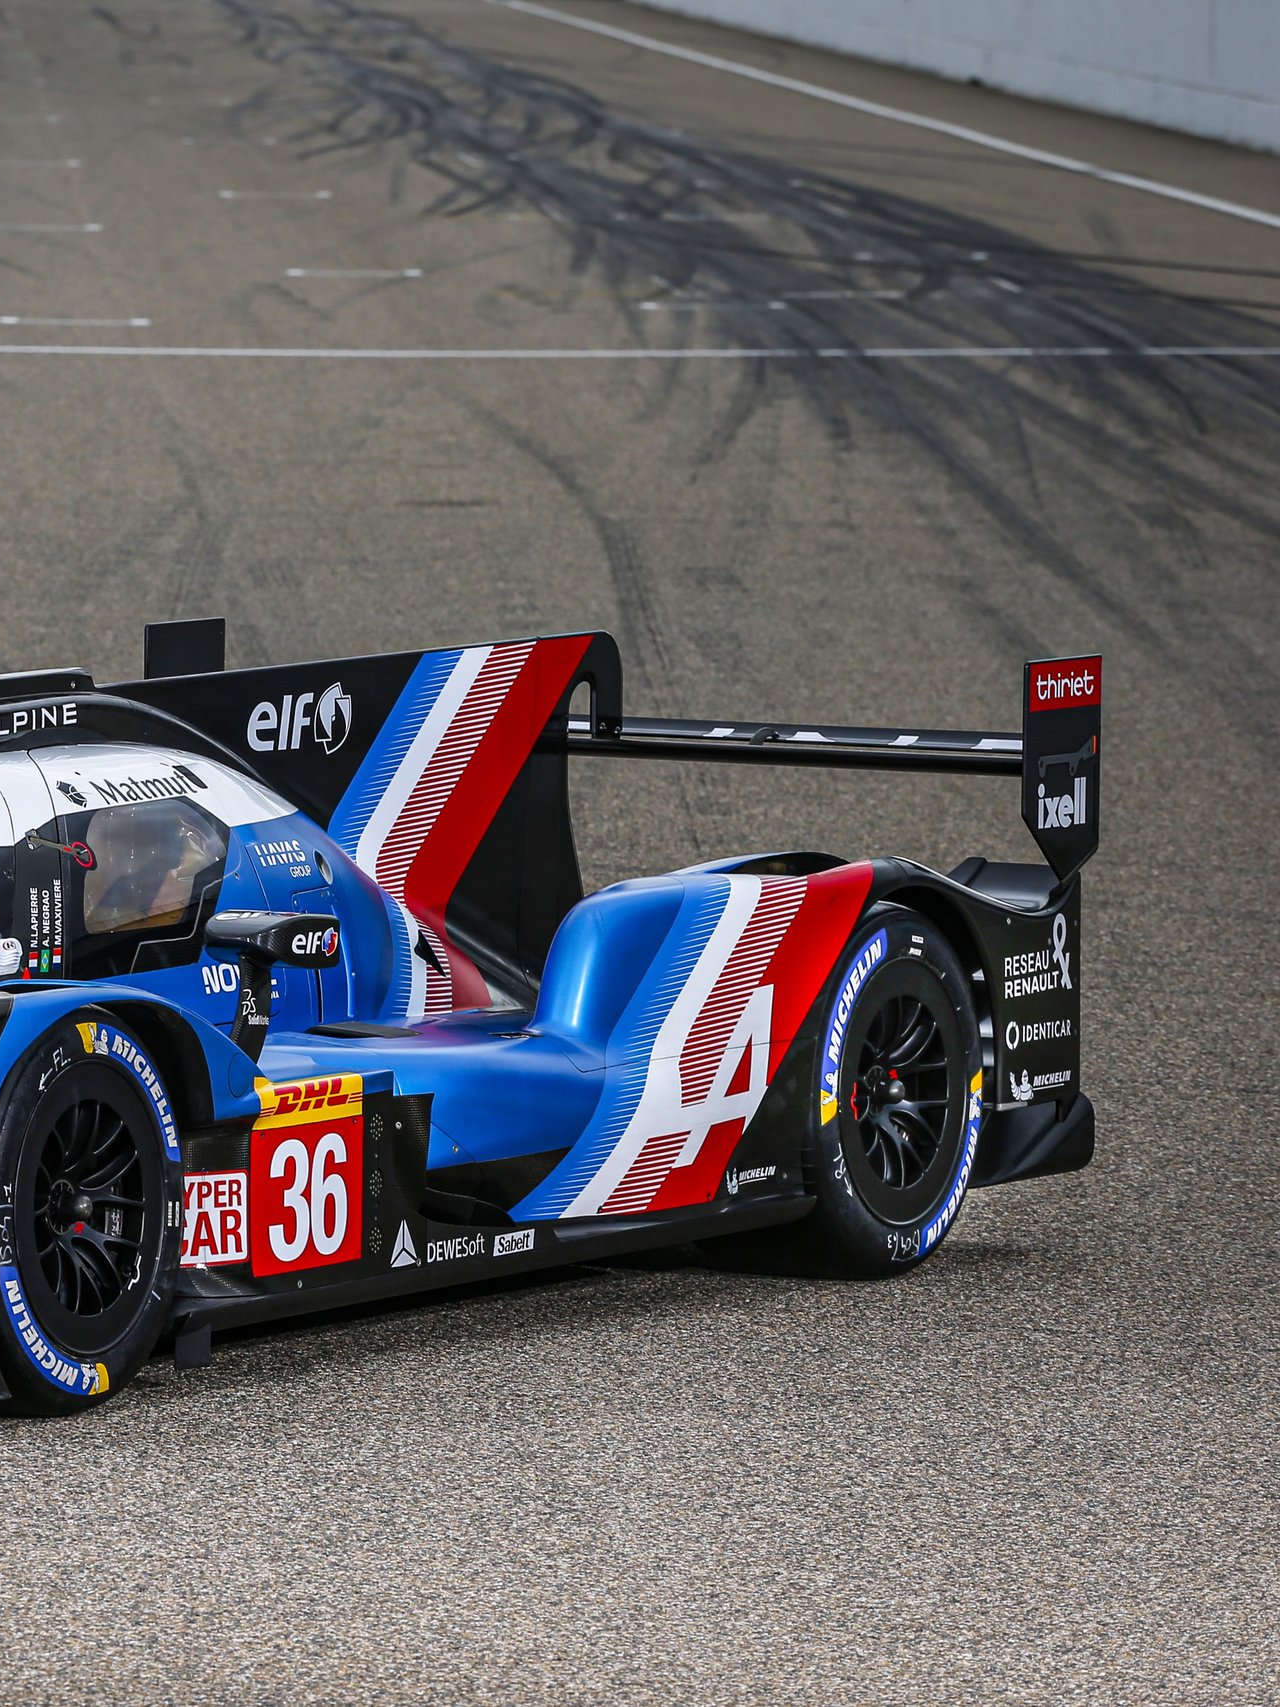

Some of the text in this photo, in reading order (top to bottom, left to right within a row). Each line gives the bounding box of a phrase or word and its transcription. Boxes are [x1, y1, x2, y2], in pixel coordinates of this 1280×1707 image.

[1036, 669, 1095, 700] thiriet
[246, 692, 315, 752] elf
[89, 770, 198, 806] Matmut
[1037, 776, 1087, 829] ixell
[254, 839, 307, 867] HAVAS
[289, 865, 312, 878] GROUP
[41, 890, 50, 934] NEGRAO
[53, 878, 62, 946] M.VAXIVIERE
[291, 931, 322, 955] elf
[1004, 949, 1050, 977] RESEAU
[1004, 970, 1059, 999] RENAULT
[827, 938, 883, 1064] MICHELIN
[1022, 1019, 1071, 1043] IDENTICAR
[111, 1034, 178, 1148] MICHELIN
[1033, 1069, 1071, 1087] MICHELIN
[273, 1077, 350, 1116] DHL
[738, 1165, 776, 1181] MICHELIN
[925, 1125, 979, 1250] MICHELIN
[184, 1179, 242, 1210] YPER
[268, 1132, 348, 1262] 36
[426, 1232, 485, 1263] DEWESoft
[497, 1233, 531, 1256] Sabelt
[5, 1280, 79, 1387] MICHELIN
